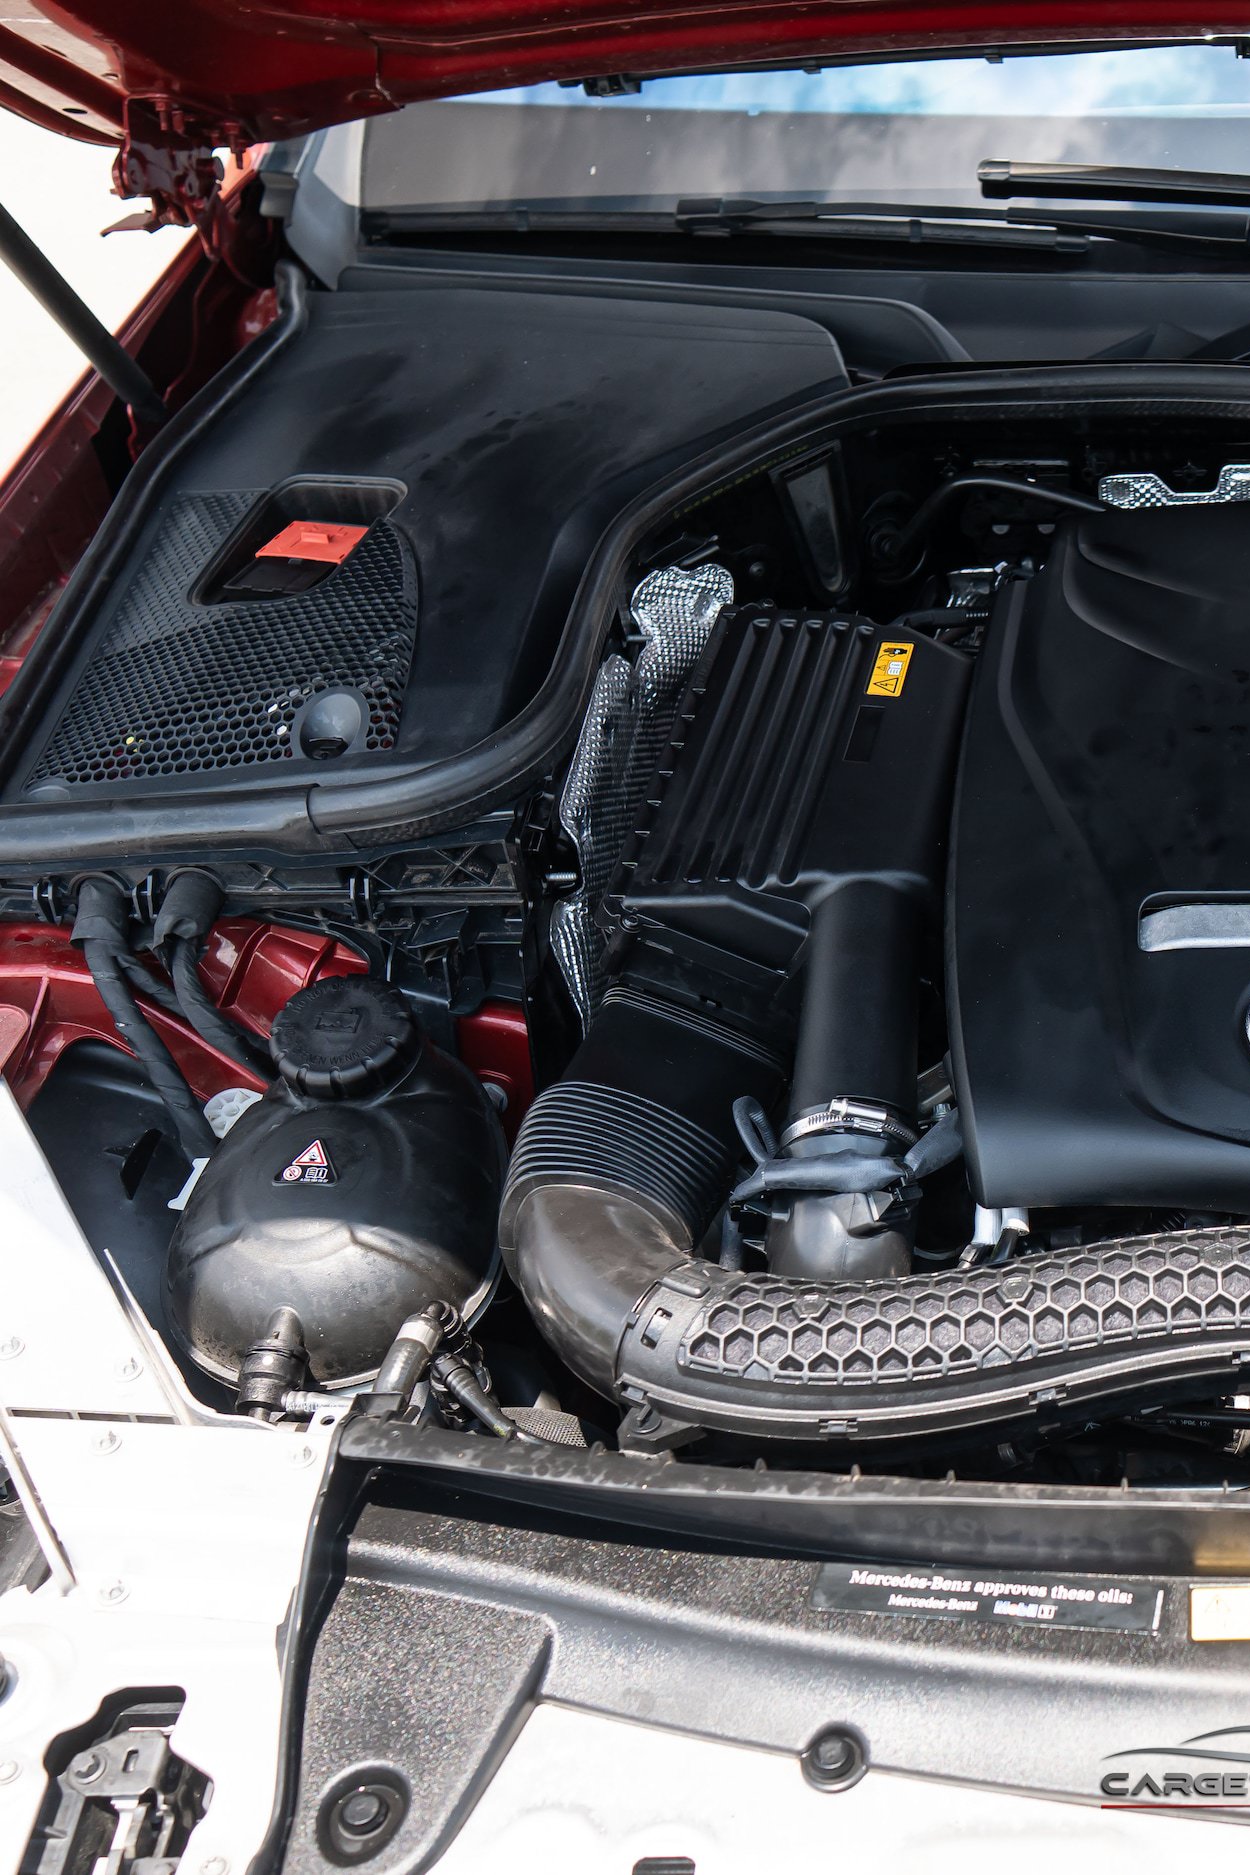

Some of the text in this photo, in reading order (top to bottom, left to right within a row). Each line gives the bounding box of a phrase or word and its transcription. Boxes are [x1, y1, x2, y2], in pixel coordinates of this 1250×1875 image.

[849, 1570, 1134, 1605] Mercedes-Benz approves these oils:
[887, 1594, 979, 1612] Mercedes-Benz
